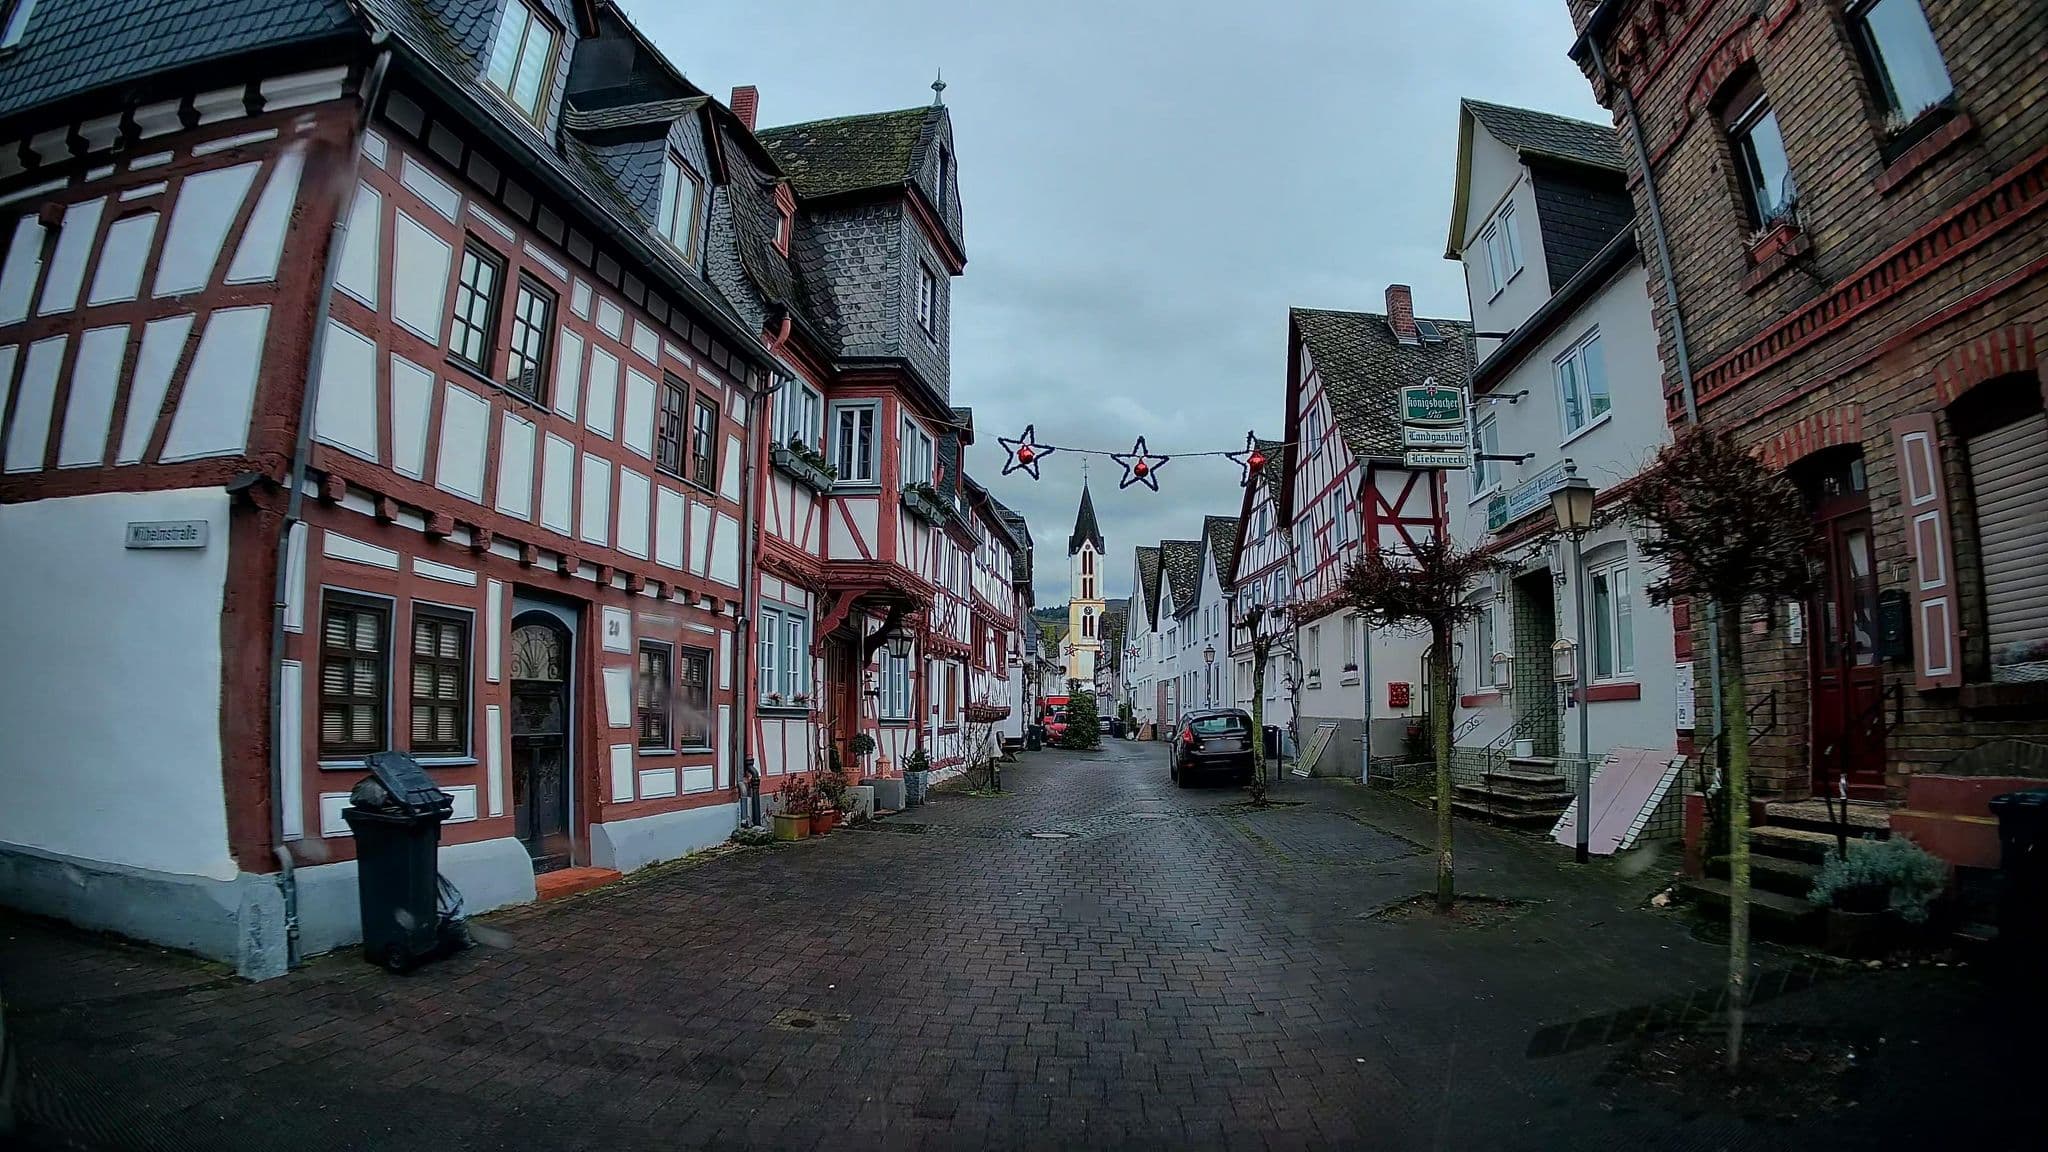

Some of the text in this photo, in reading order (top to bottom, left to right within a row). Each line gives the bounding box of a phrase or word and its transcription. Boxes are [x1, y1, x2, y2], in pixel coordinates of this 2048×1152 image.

[1408, 397, 1458, 409] Königsbacher
[1408, 431, 1464, 444] Landgasthof
[1411, 454, 1464, 464] Liebeneck
